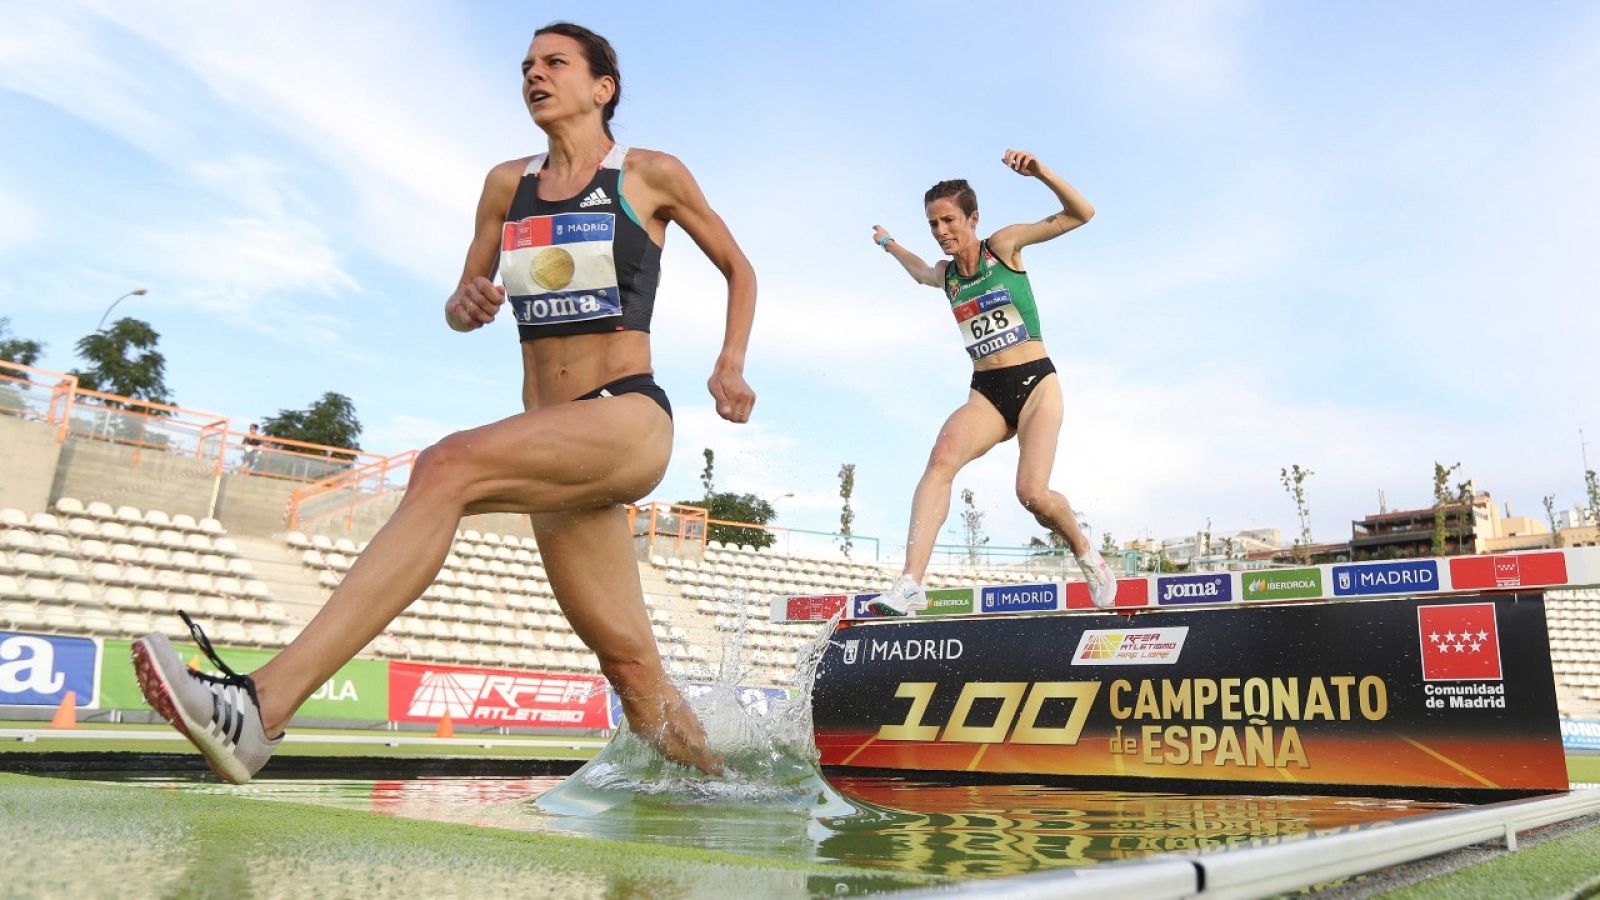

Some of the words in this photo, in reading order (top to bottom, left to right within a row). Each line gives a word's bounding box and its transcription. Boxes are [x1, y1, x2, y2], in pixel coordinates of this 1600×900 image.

[580, 197, 612, 209] adidas
[568, 222, 608, 233] MADRID
[970, 310, 1009, 340] 628
[1267, 577, 1316, 592] IBERDROLA
[1360, 568, 1432, 587] MADRID
[933, 597, 970, 608] IBERDROLA
[1002, 590, 1054, 606] MADRID
[870, 639, 963, 661] MADRID
[1120, 642, 1176, 650] ATLETISMO
[1424, 683, 1505, 697] Comunidad
[1109, 675, 1389, 722] CAMPEONATO
[1425, 696, 1446, 708] de
[1449, 695, 1506, 709] Madrid
[473, 706, 586, 722] ATLETISMO
[877, 680, 1102, 745] 100
[1109, 725, 1138, 756] de
[1142, 715, 1310, 769] ESPAÑA
